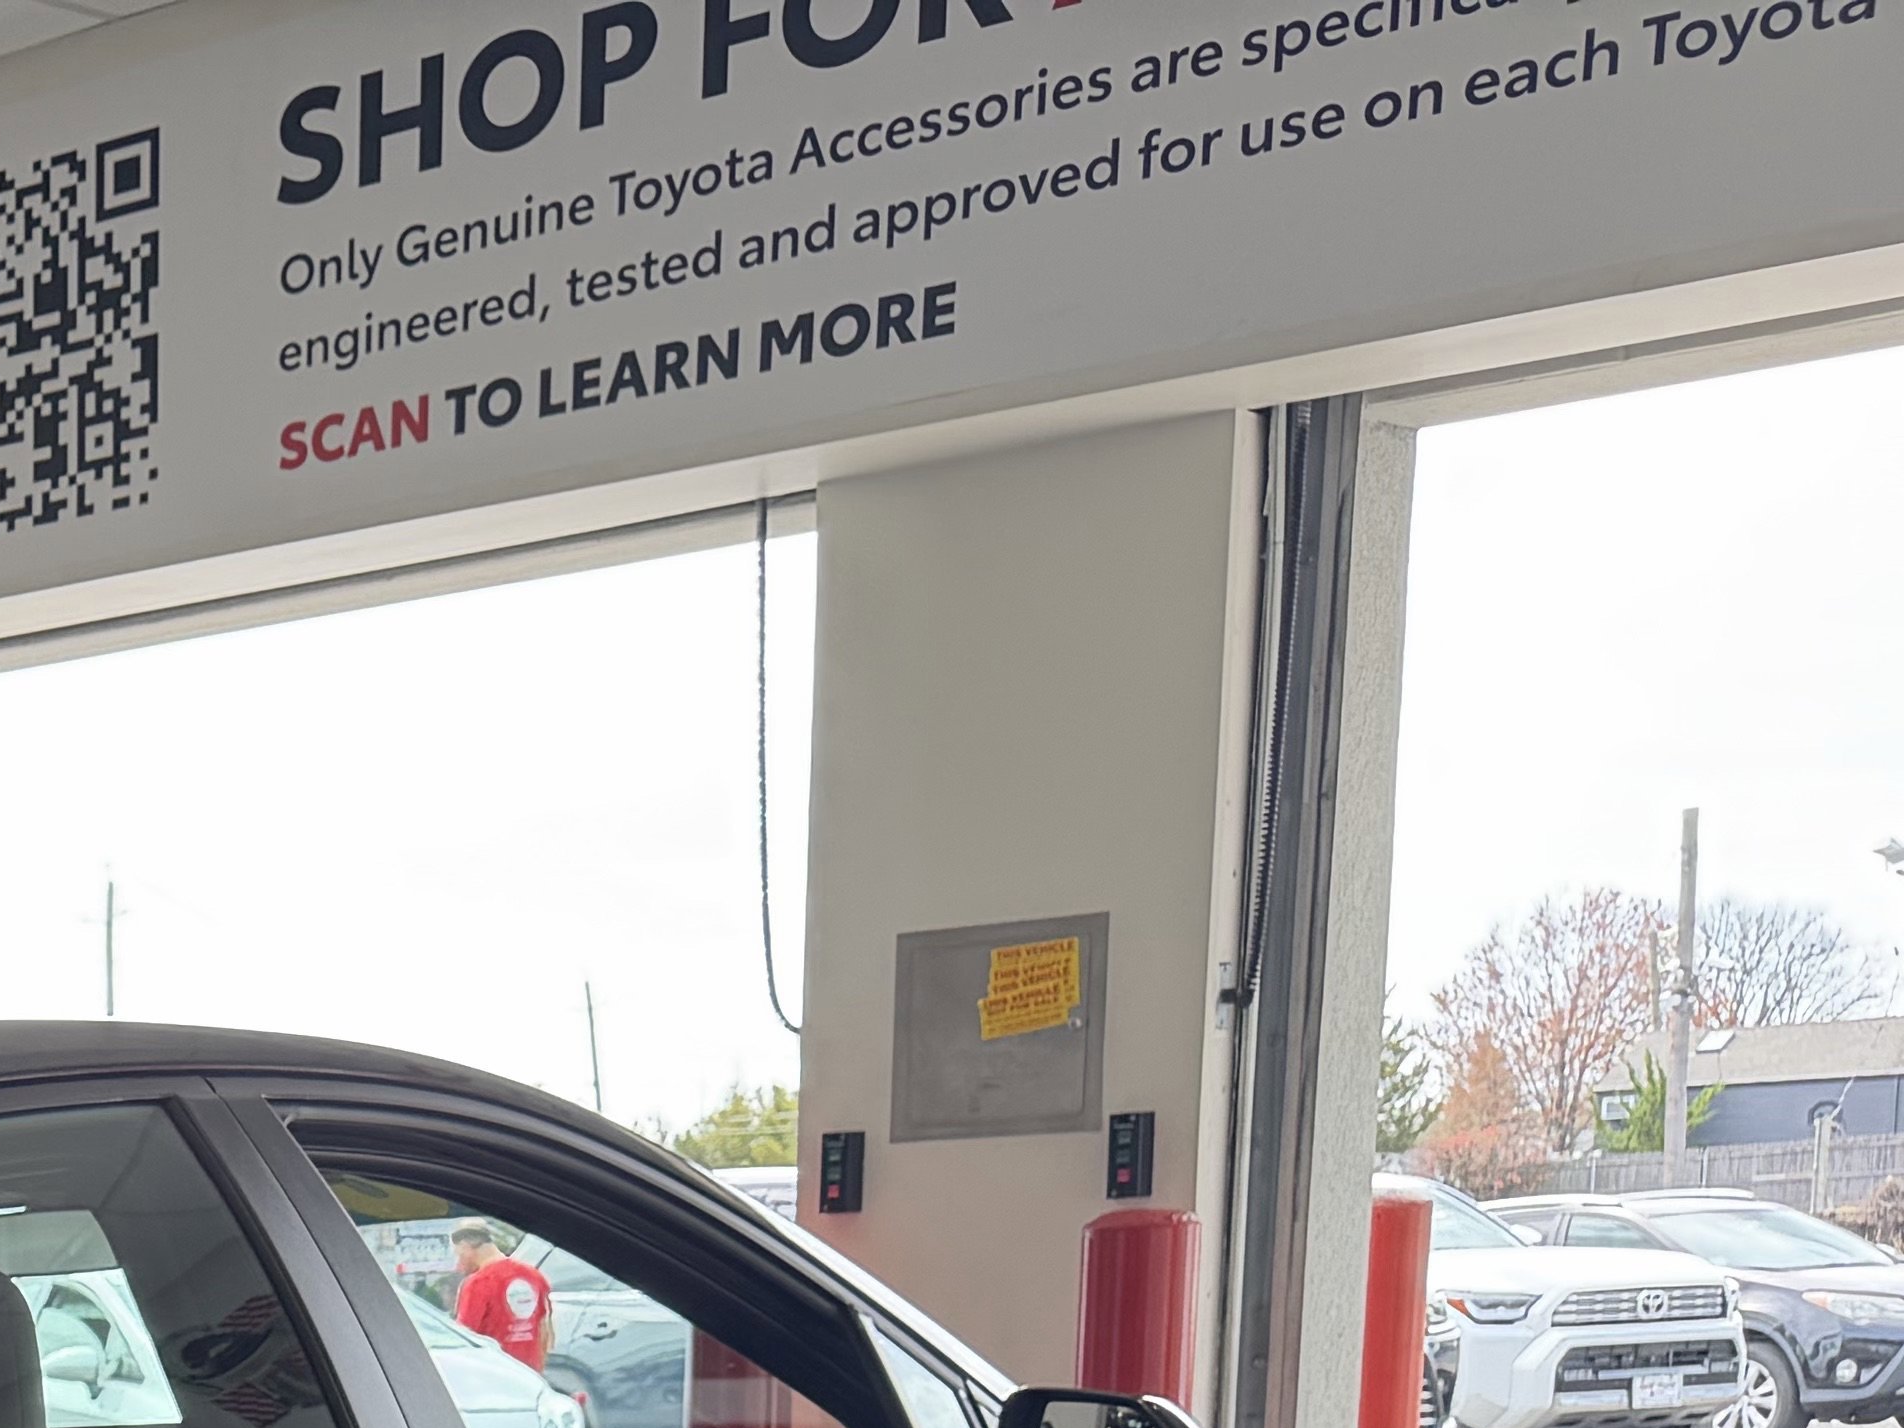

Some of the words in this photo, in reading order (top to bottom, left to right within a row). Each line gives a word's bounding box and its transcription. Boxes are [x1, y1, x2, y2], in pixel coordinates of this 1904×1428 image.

[276, 1, 658, 206] SHOP
[280, 274, 550, 371] engineered,
[567, 231, 722, 308] tested
[739, 204, 836, 268] and
[853, 138, 1120, 248] approved
[1139, 128, 1223, 180] for
[1240, 103, 1345, 157] use
[1364, 78, 1444, 128] on
[1464, 28, 1620, 106] each
[1643, 0, 1879, 66] Toyota
[281, 240, 383, 294] Only
[396, 194, 594, 267] Genuine
[609, 148, 773, 217] Toyota
[790, 69, 1111, 174] Accessories
[1131, 39, 1223, 93] are
[280, 395, 430, 470] SCAN
[445, 377, 523, 436] TO
[538, 327, 740, 418] LEARN
[758, 281, 957, 373] MORE
